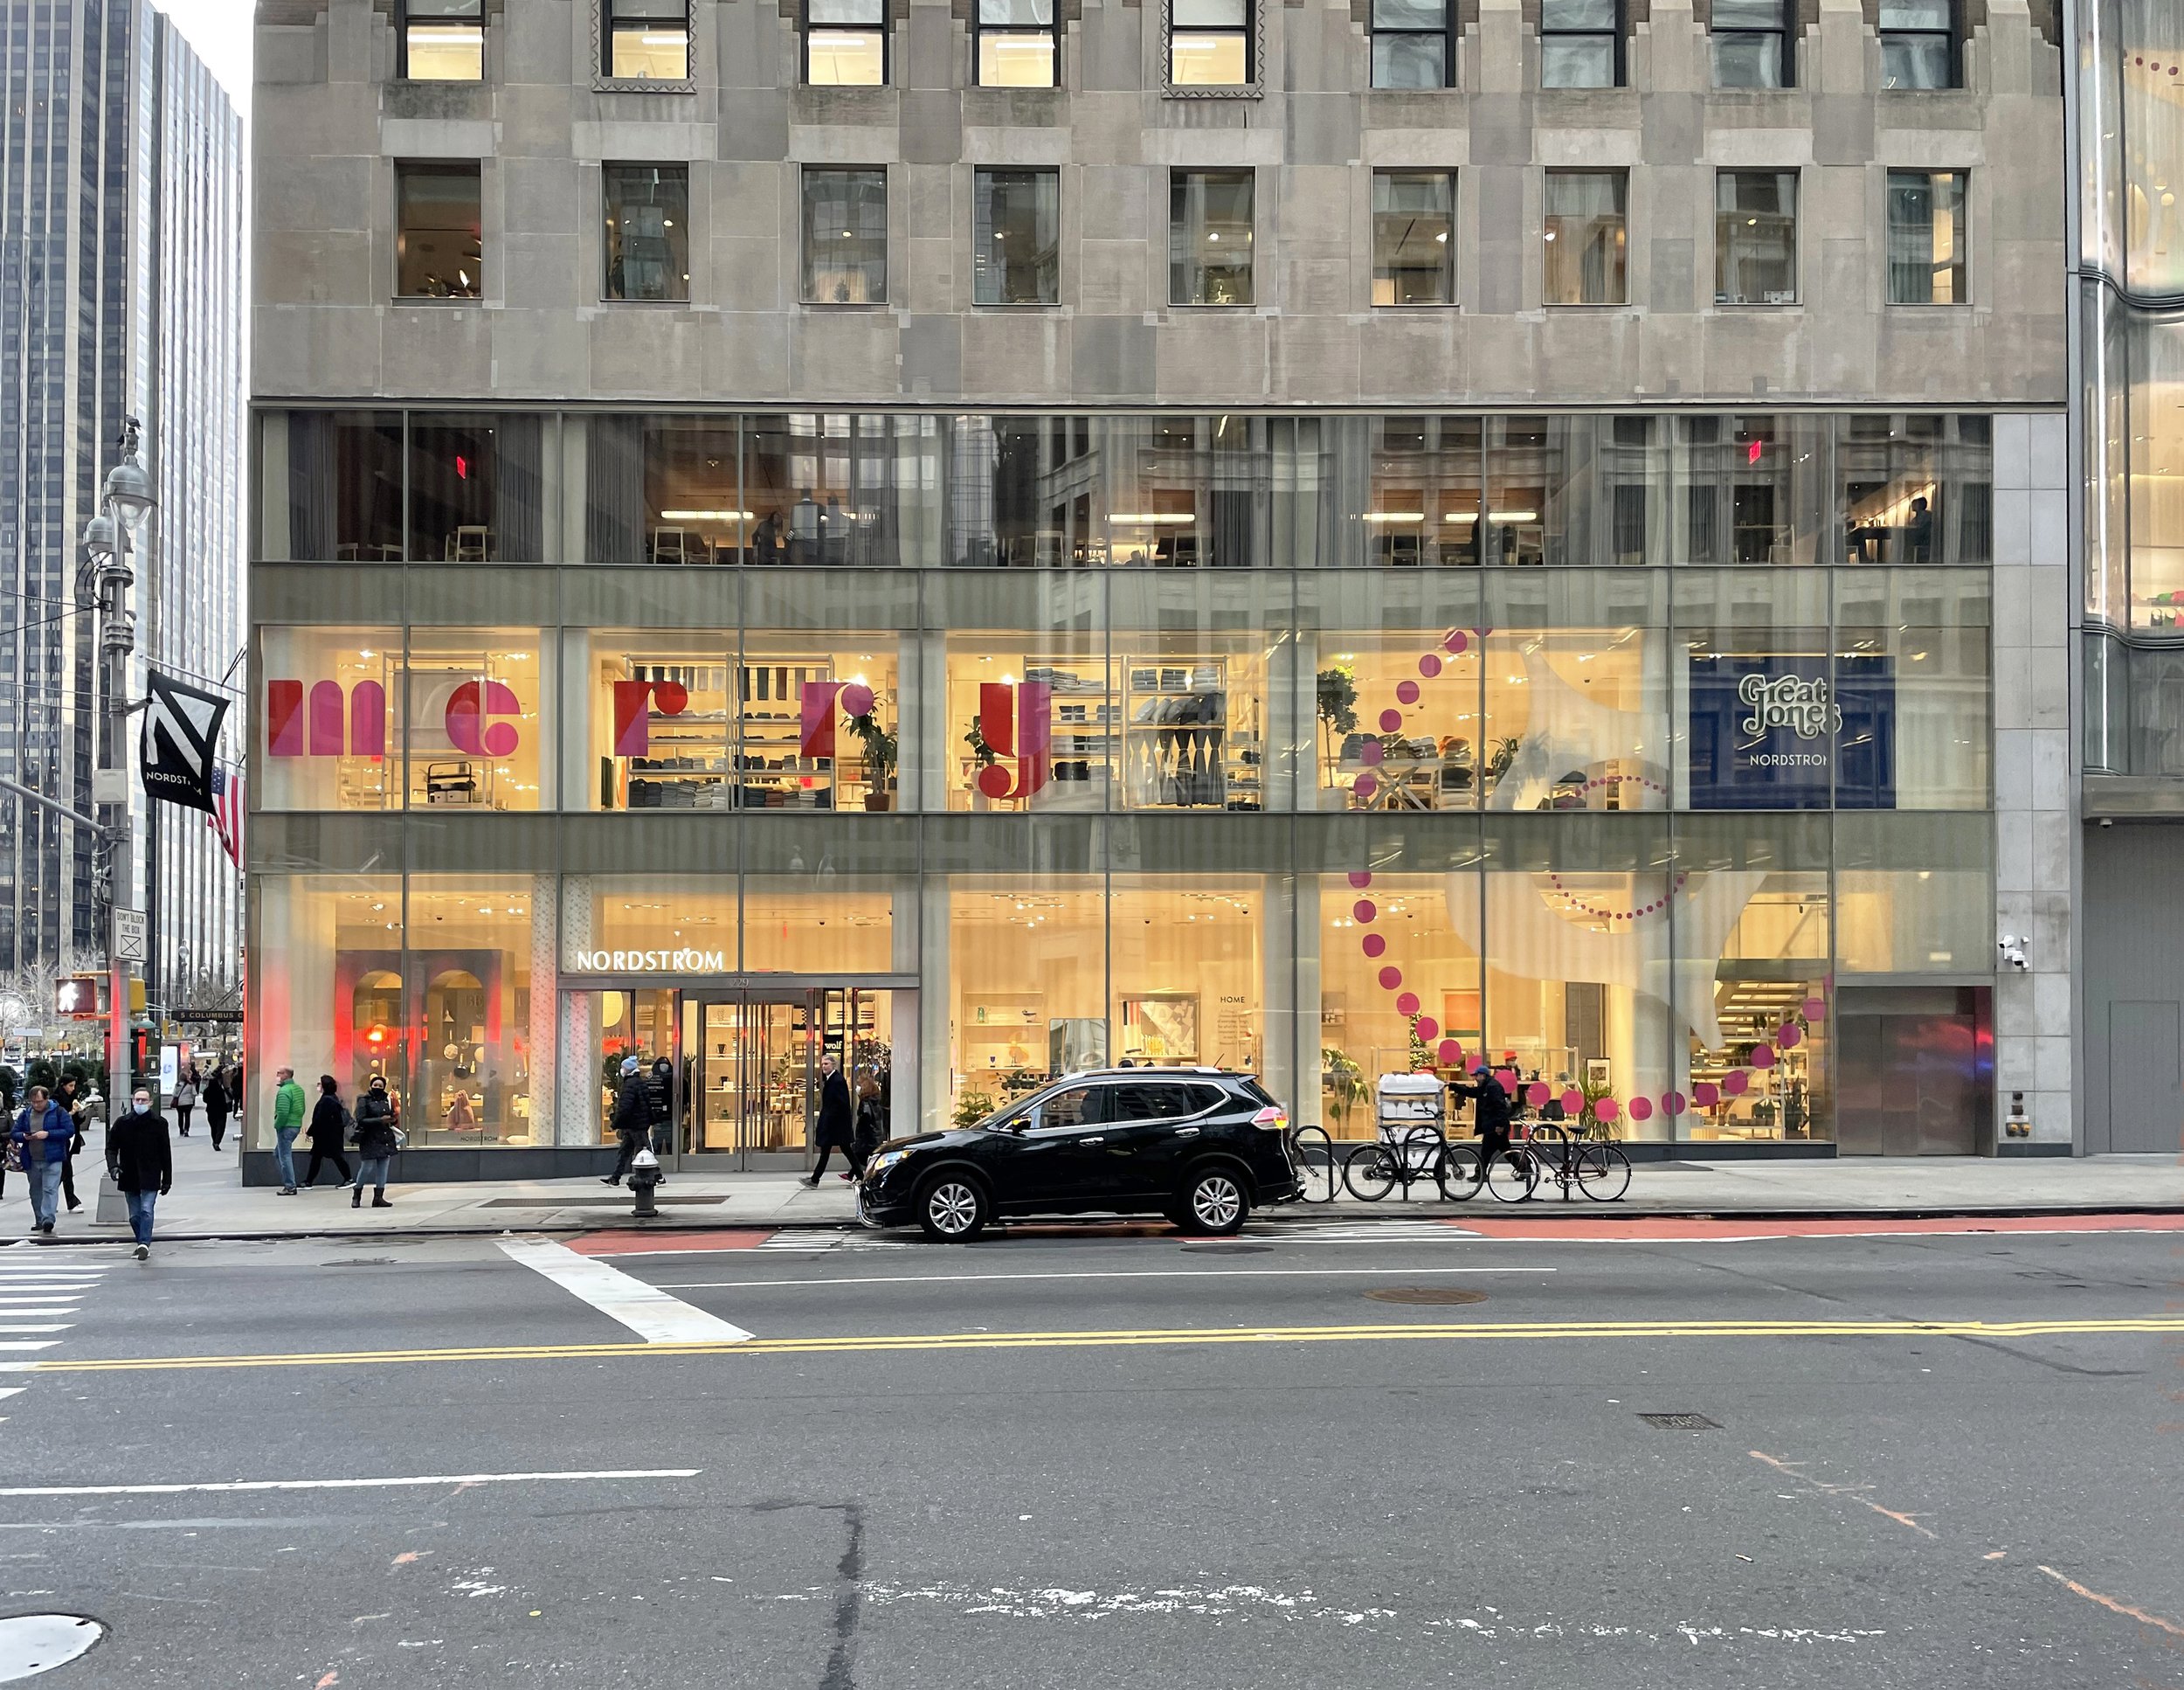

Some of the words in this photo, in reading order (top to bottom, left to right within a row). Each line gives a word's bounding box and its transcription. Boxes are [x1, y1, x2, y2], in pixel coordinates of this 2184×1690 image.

[1738, 674, 1827, 706] Great
[1750, 754, 1827, 765] NORDSTRO
[577, 950, 723, 971] NORDSTROM
[825, 1041, 842, 1049] wolf
